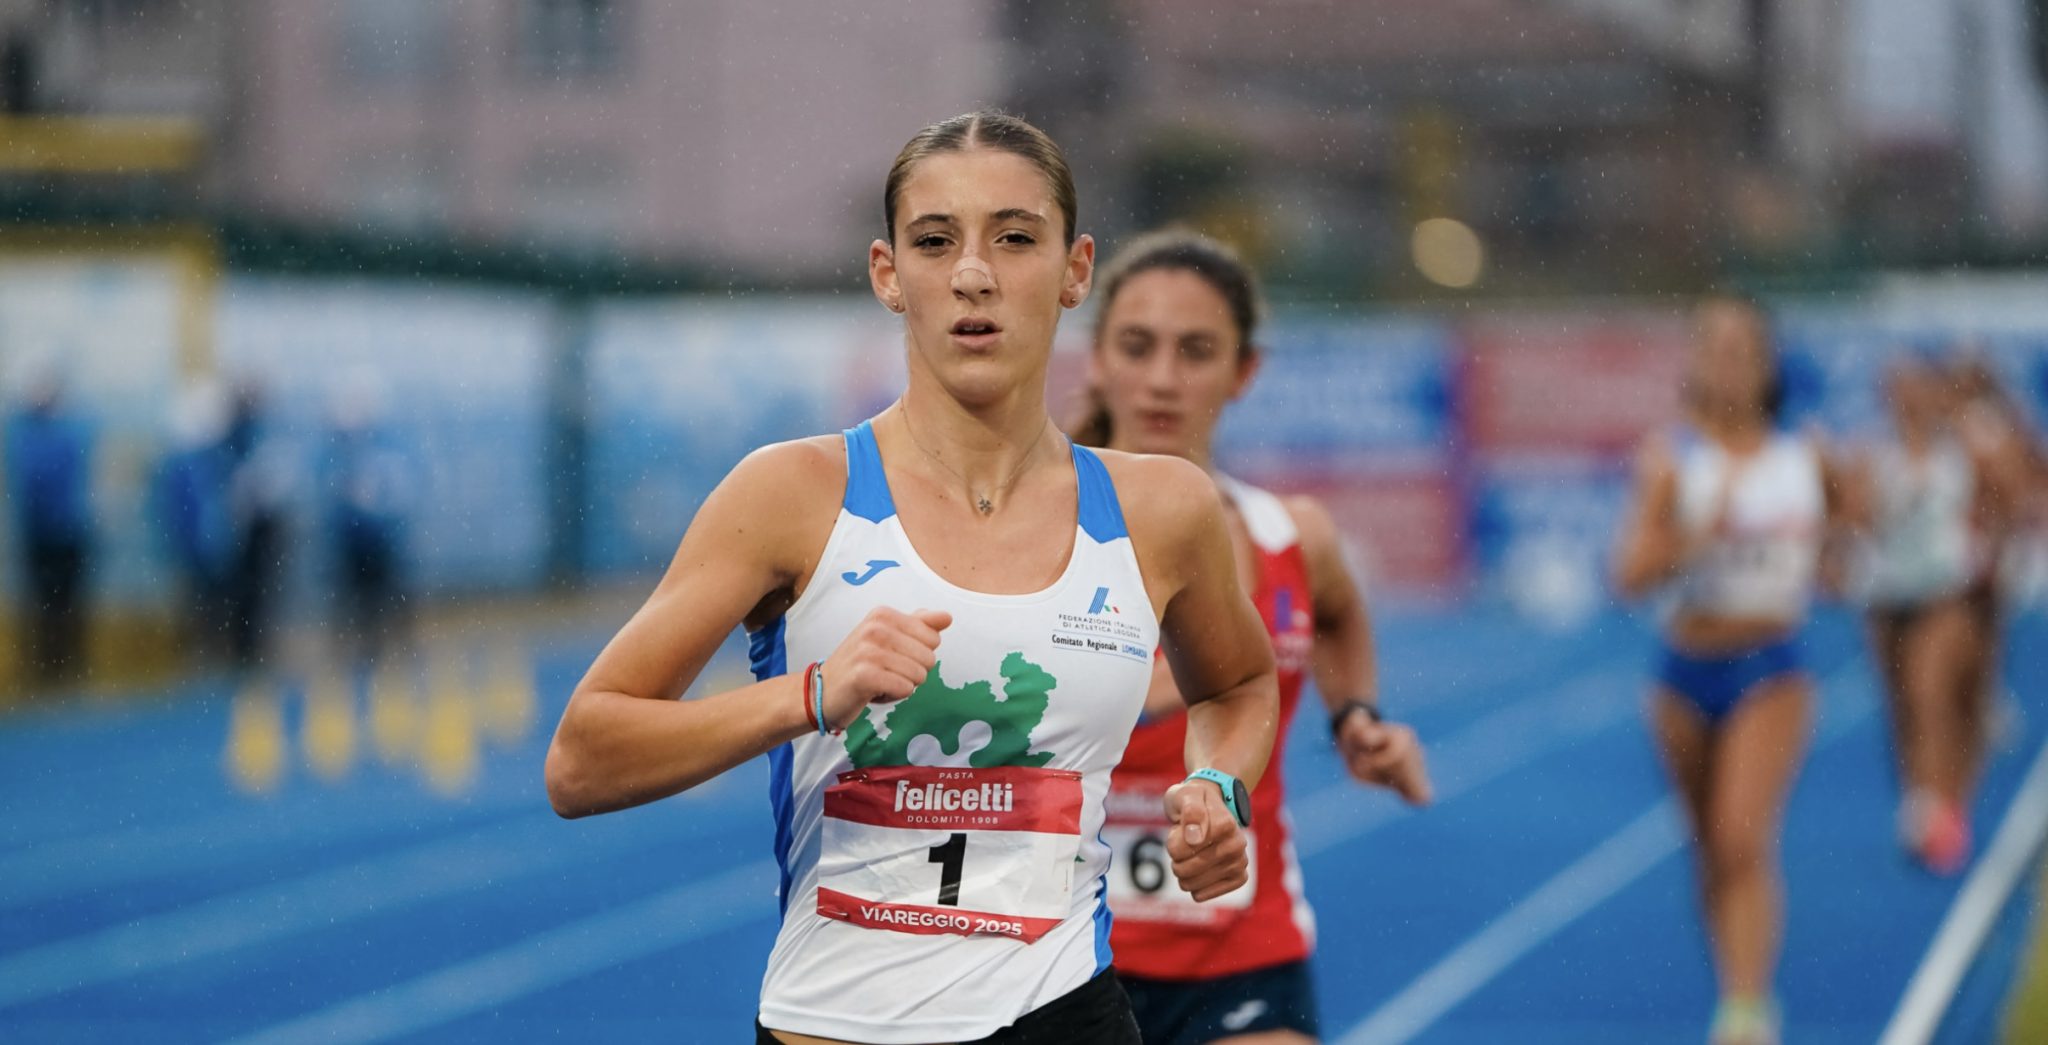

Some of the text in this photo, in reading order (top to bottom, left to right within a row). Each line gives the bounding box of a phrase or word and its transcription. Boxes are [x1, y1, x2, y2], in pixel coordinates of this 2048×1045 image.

[1058, 613, 1111, 626] FEDERAZIONE
[1075, 624, 1111, 632] ATLETICA
[1114, 628, 1140, 639] LEGGERA
[1052, 633, 1083, 647] Comitato
[1087, 638, 1117, 651] Regionale
[894, 780, 1013, 812] felicetti
[907, 815, 999, 824] DOLOMITI 1908
[928, 833, 967, 906] 1
[860, 906, 1022, 936] VIAREGGIO 2025
